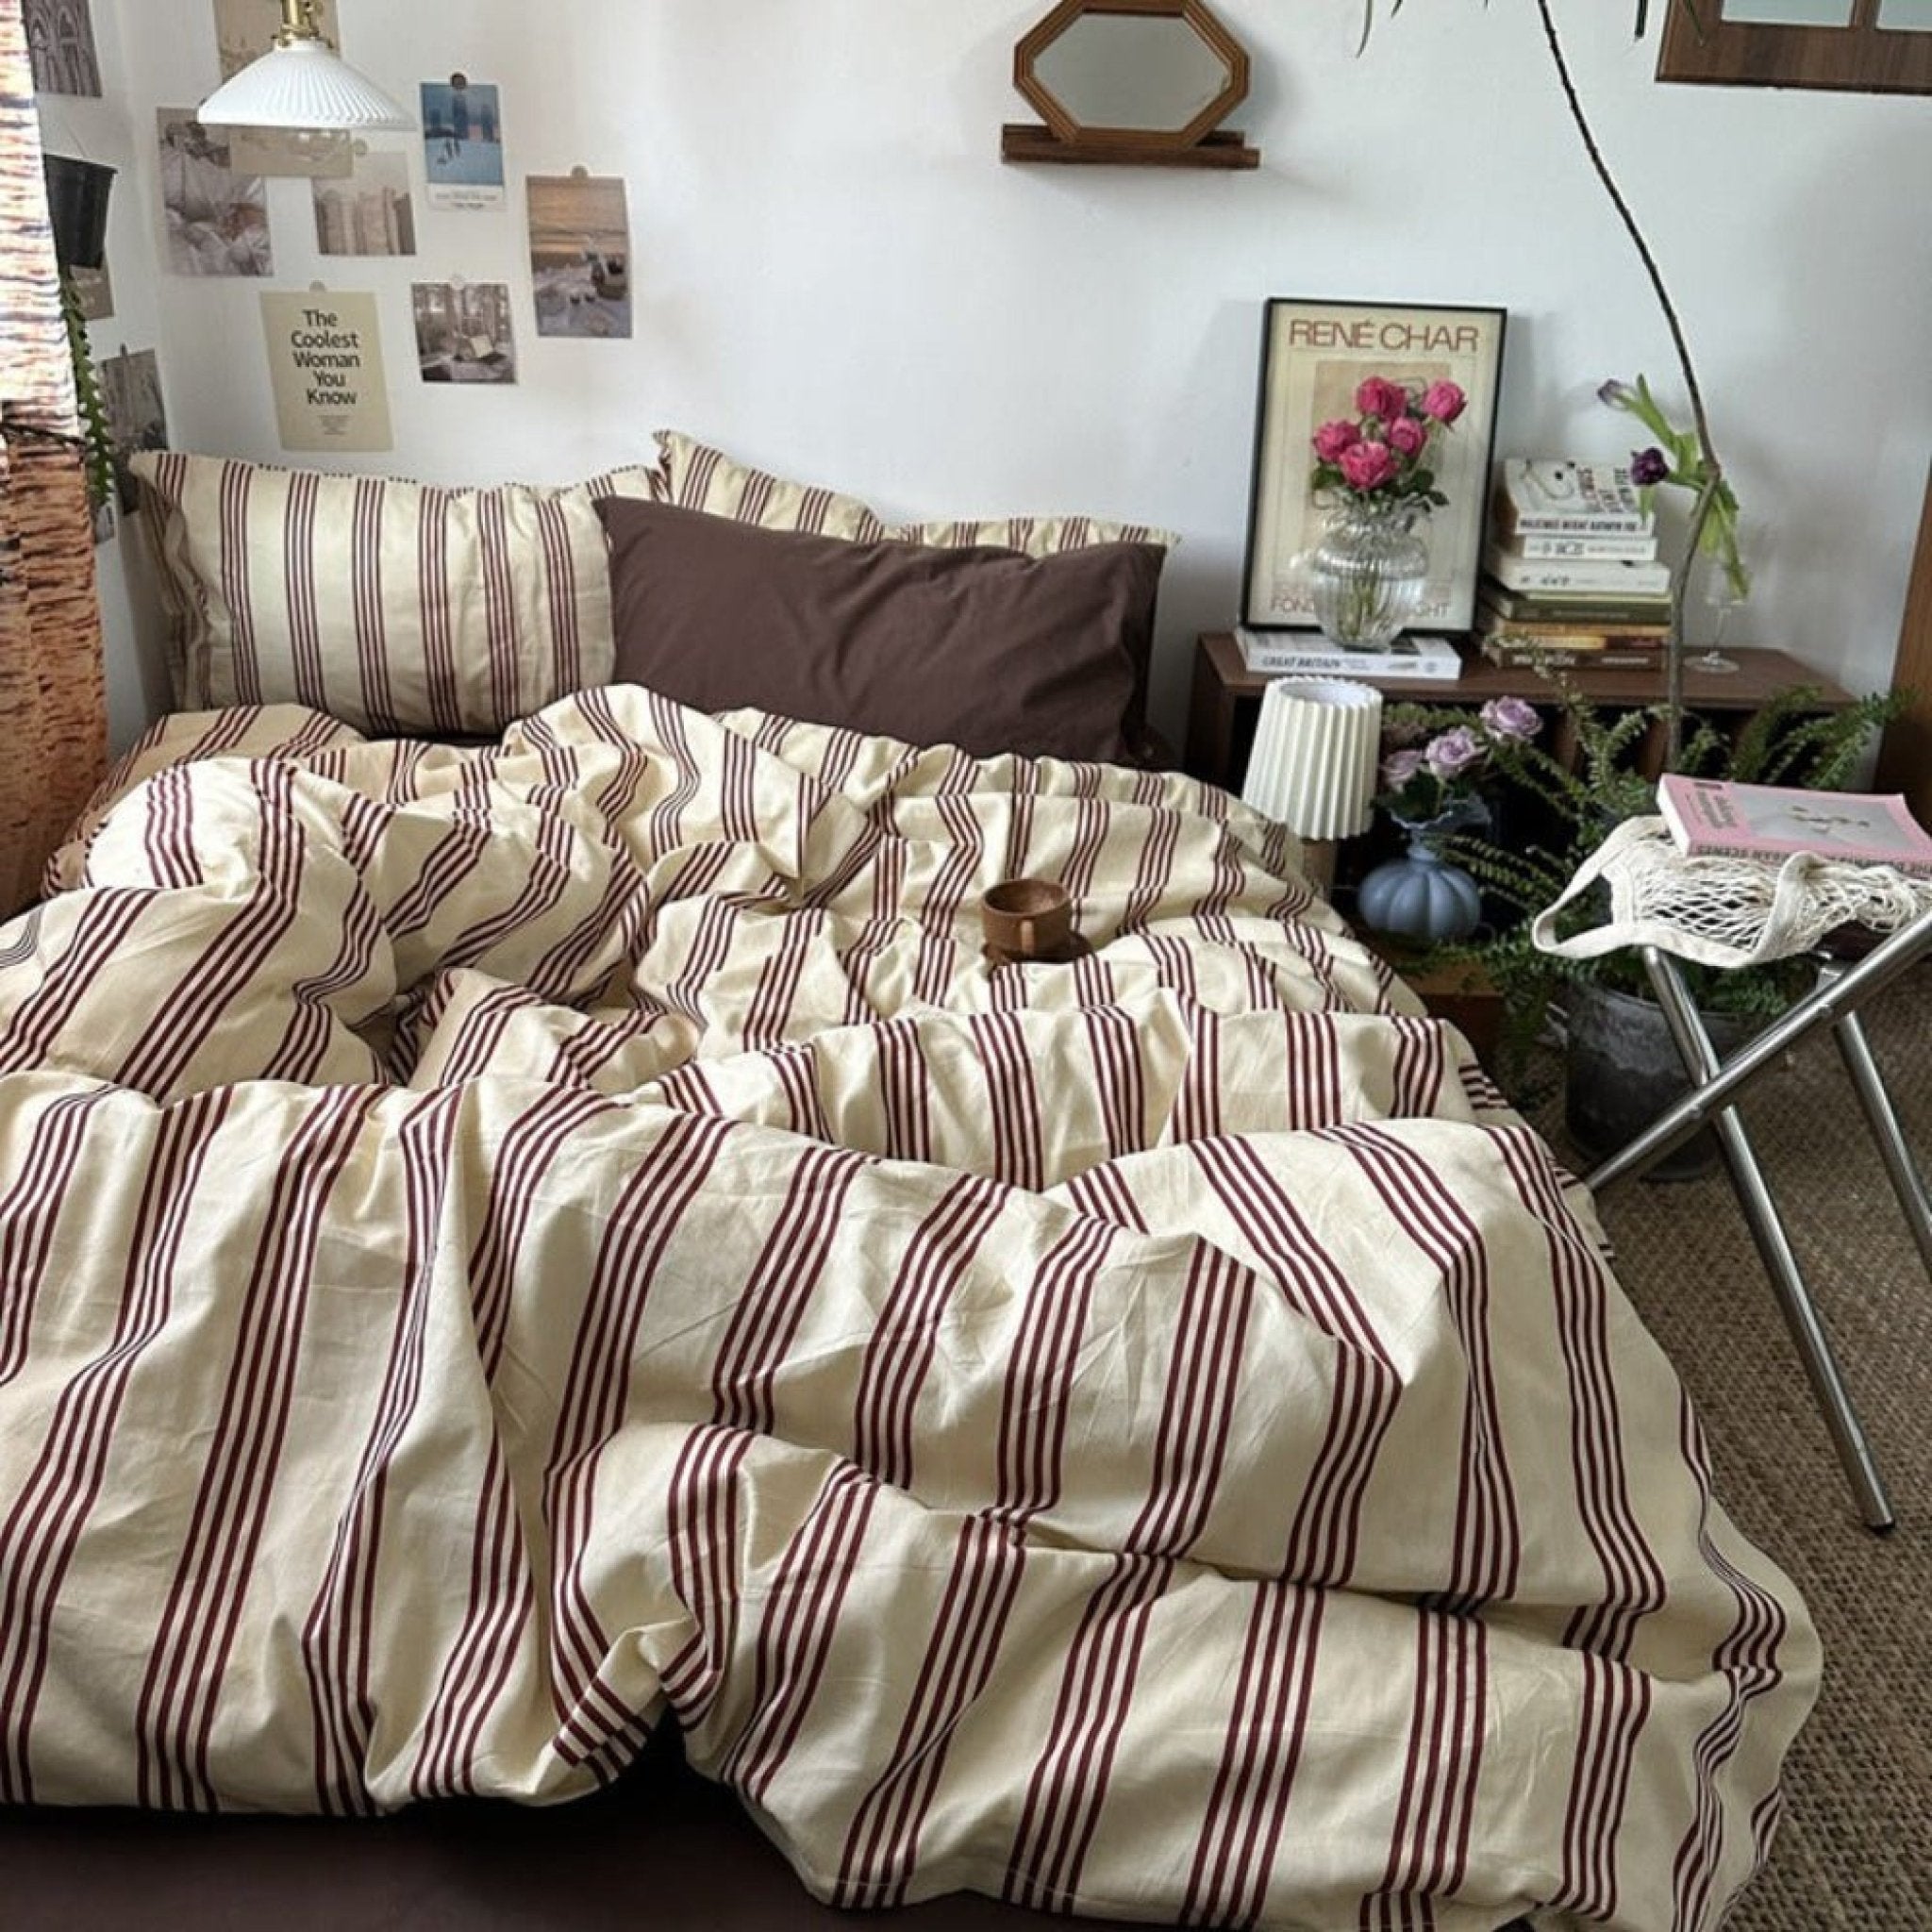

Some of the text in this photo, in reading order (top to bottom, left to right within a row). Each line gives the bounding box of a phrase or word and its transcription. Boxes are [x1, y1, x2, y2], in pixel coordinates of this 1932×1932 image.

[302, 308, 338, 326] The
[291, 330, 359, 348] Coolest
[1289, 319, 1479, 352] RENÉ CHAR
[292, 351, 360, 367] Woman
[312, 370, 347, 387] You
[307, 388, 357, 405] Know
